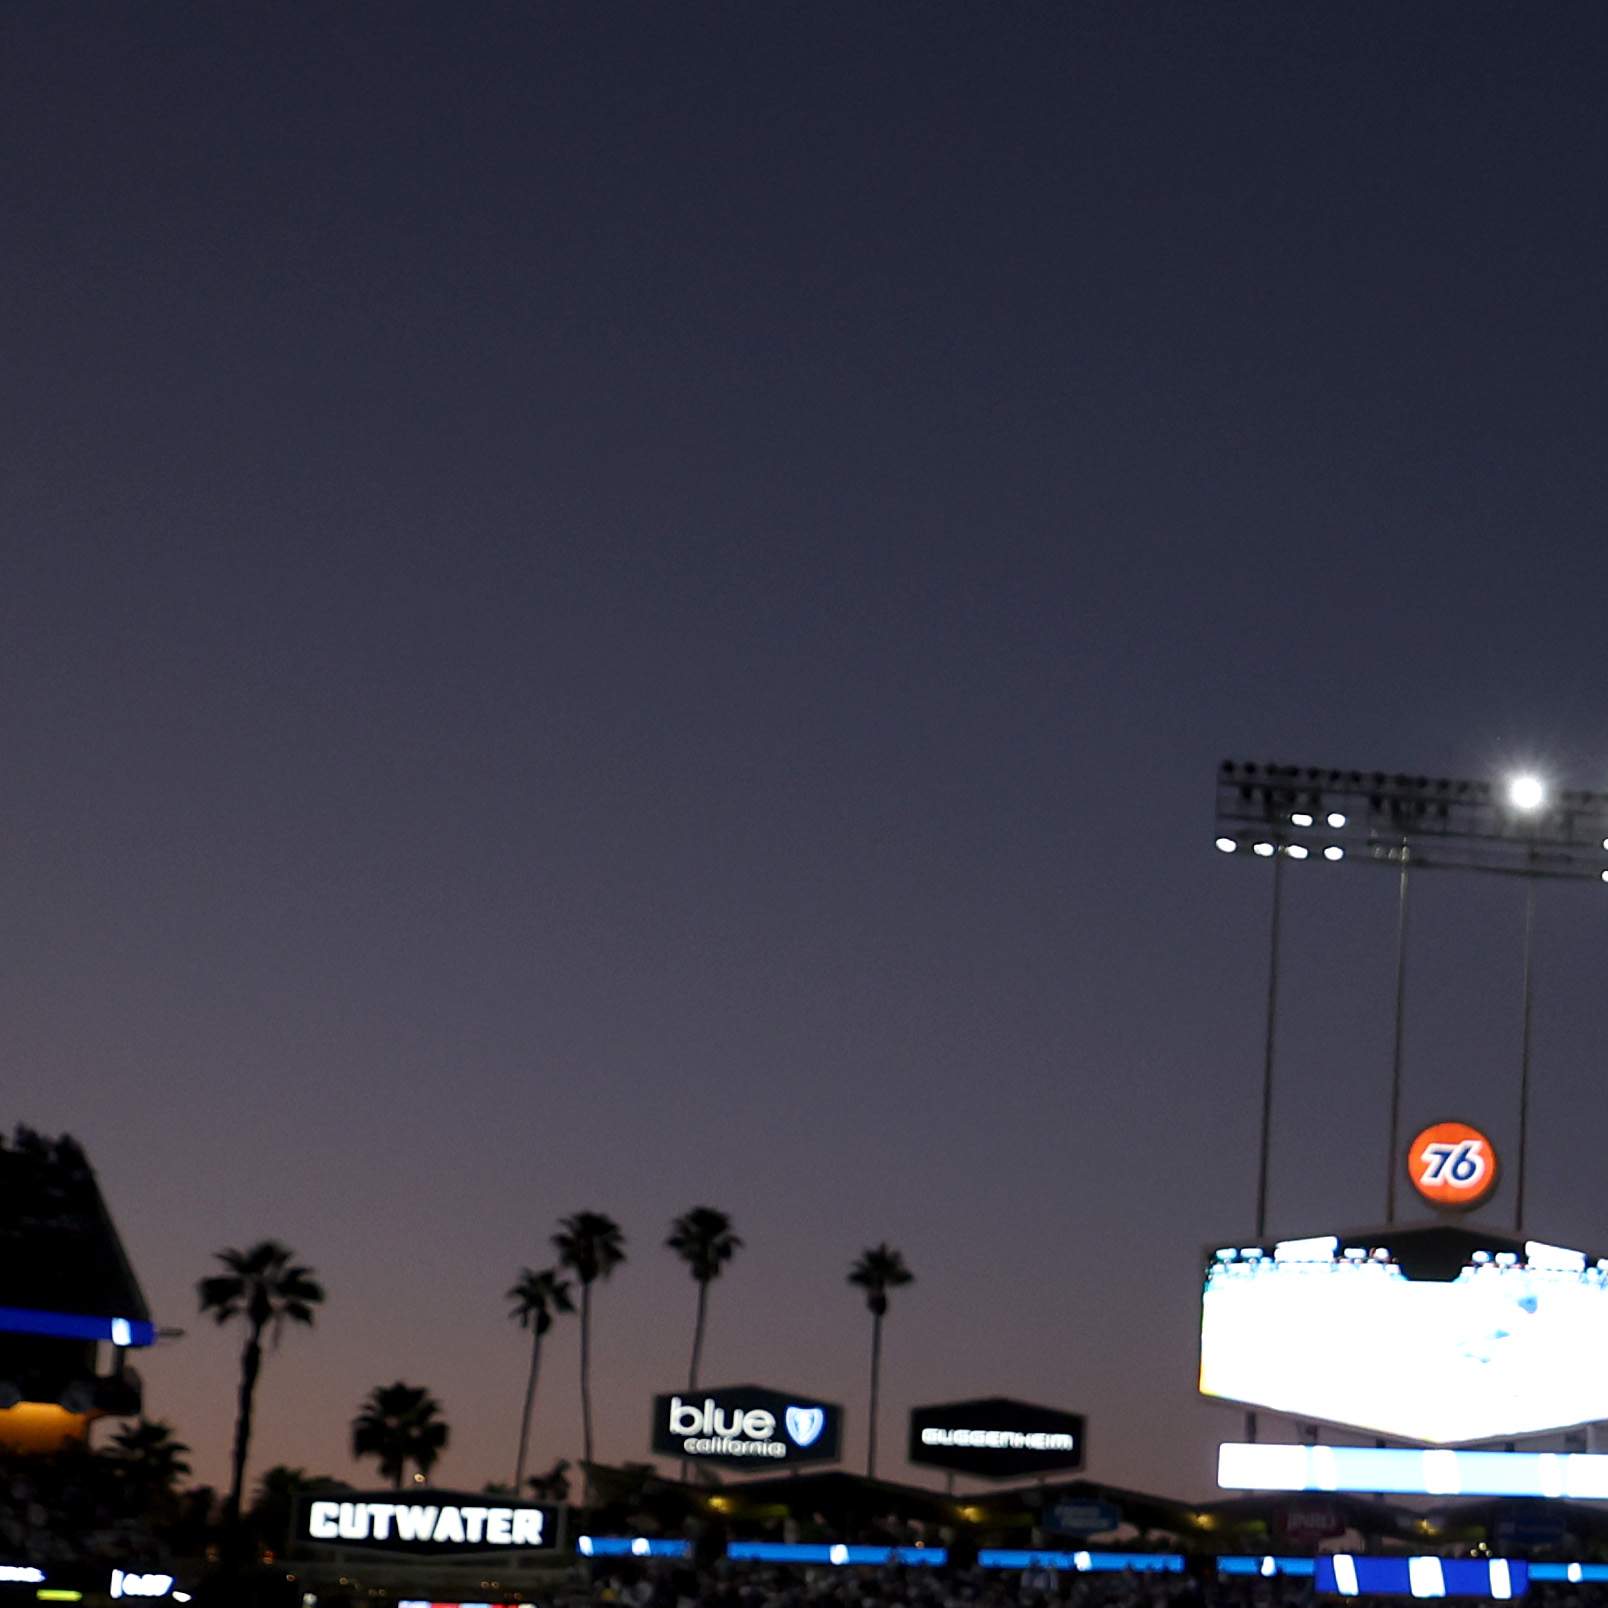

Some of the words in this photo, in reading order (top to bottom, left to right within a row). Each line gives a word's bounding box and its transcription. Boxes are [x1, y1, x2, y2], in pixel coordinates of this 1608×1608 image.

[1421, 1139, 1486, 1188] 76
[669, 1397, 776, 1438] blue
[684, 1437, 787, 1458] california
[309, 1501, 543, 1545] CUTWATER
